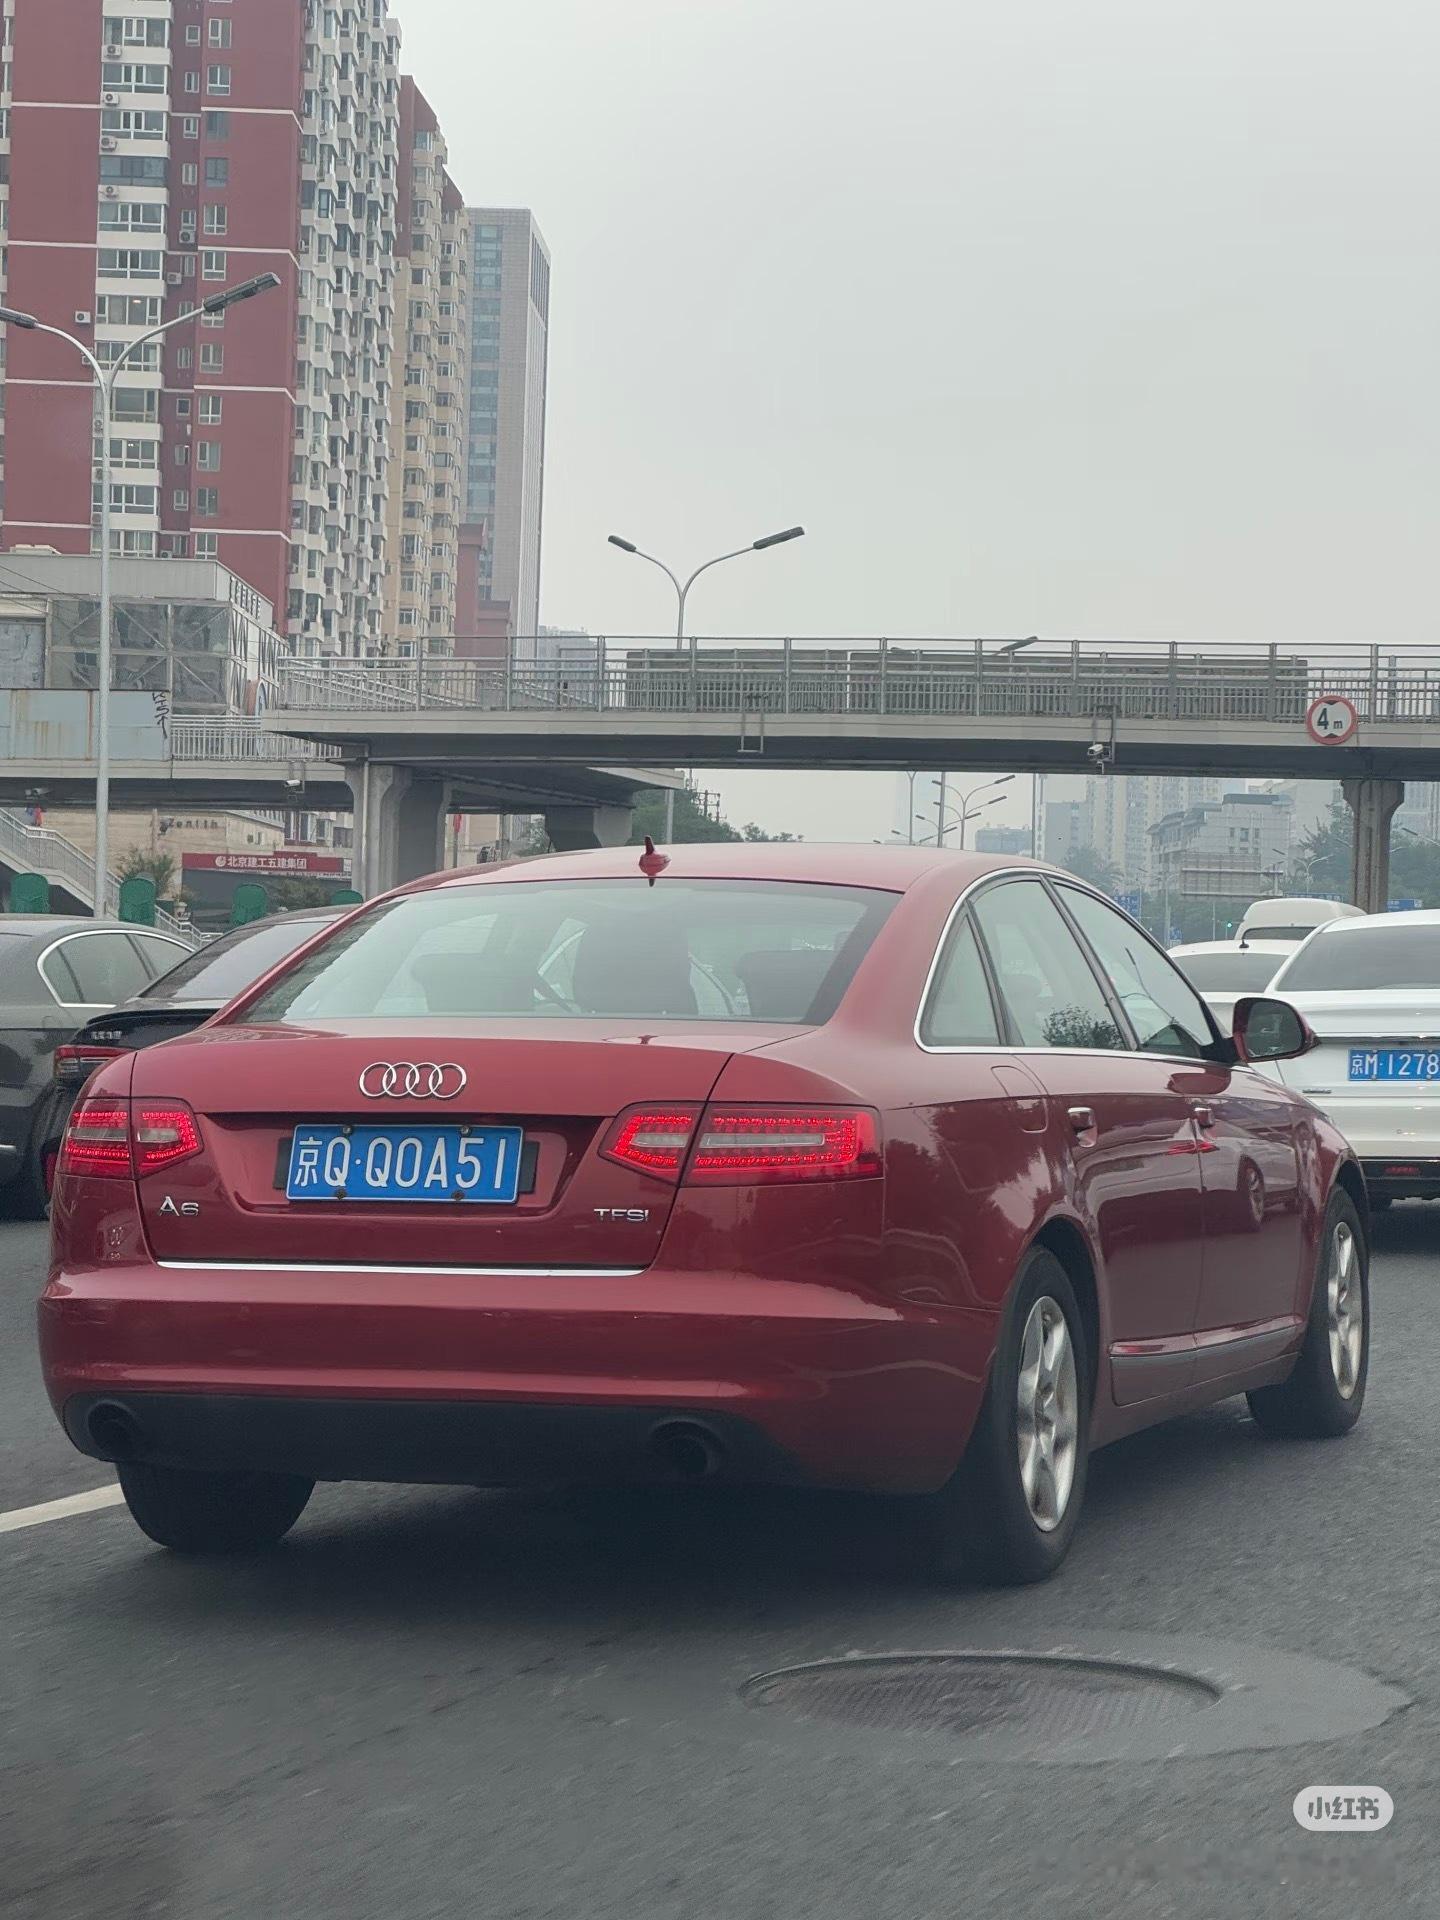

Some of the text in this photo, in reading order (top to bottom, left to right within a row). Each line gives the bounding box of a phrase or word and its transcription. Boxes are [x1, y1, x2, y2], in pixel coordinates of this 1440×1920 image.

[1317, 708, 1343, 729] 4 m
[227, 857, 307, 869] 北京建工五建集团
[160, 1196, 199, 1216] A6
[594, 1208, 649, 1221] TFSI
